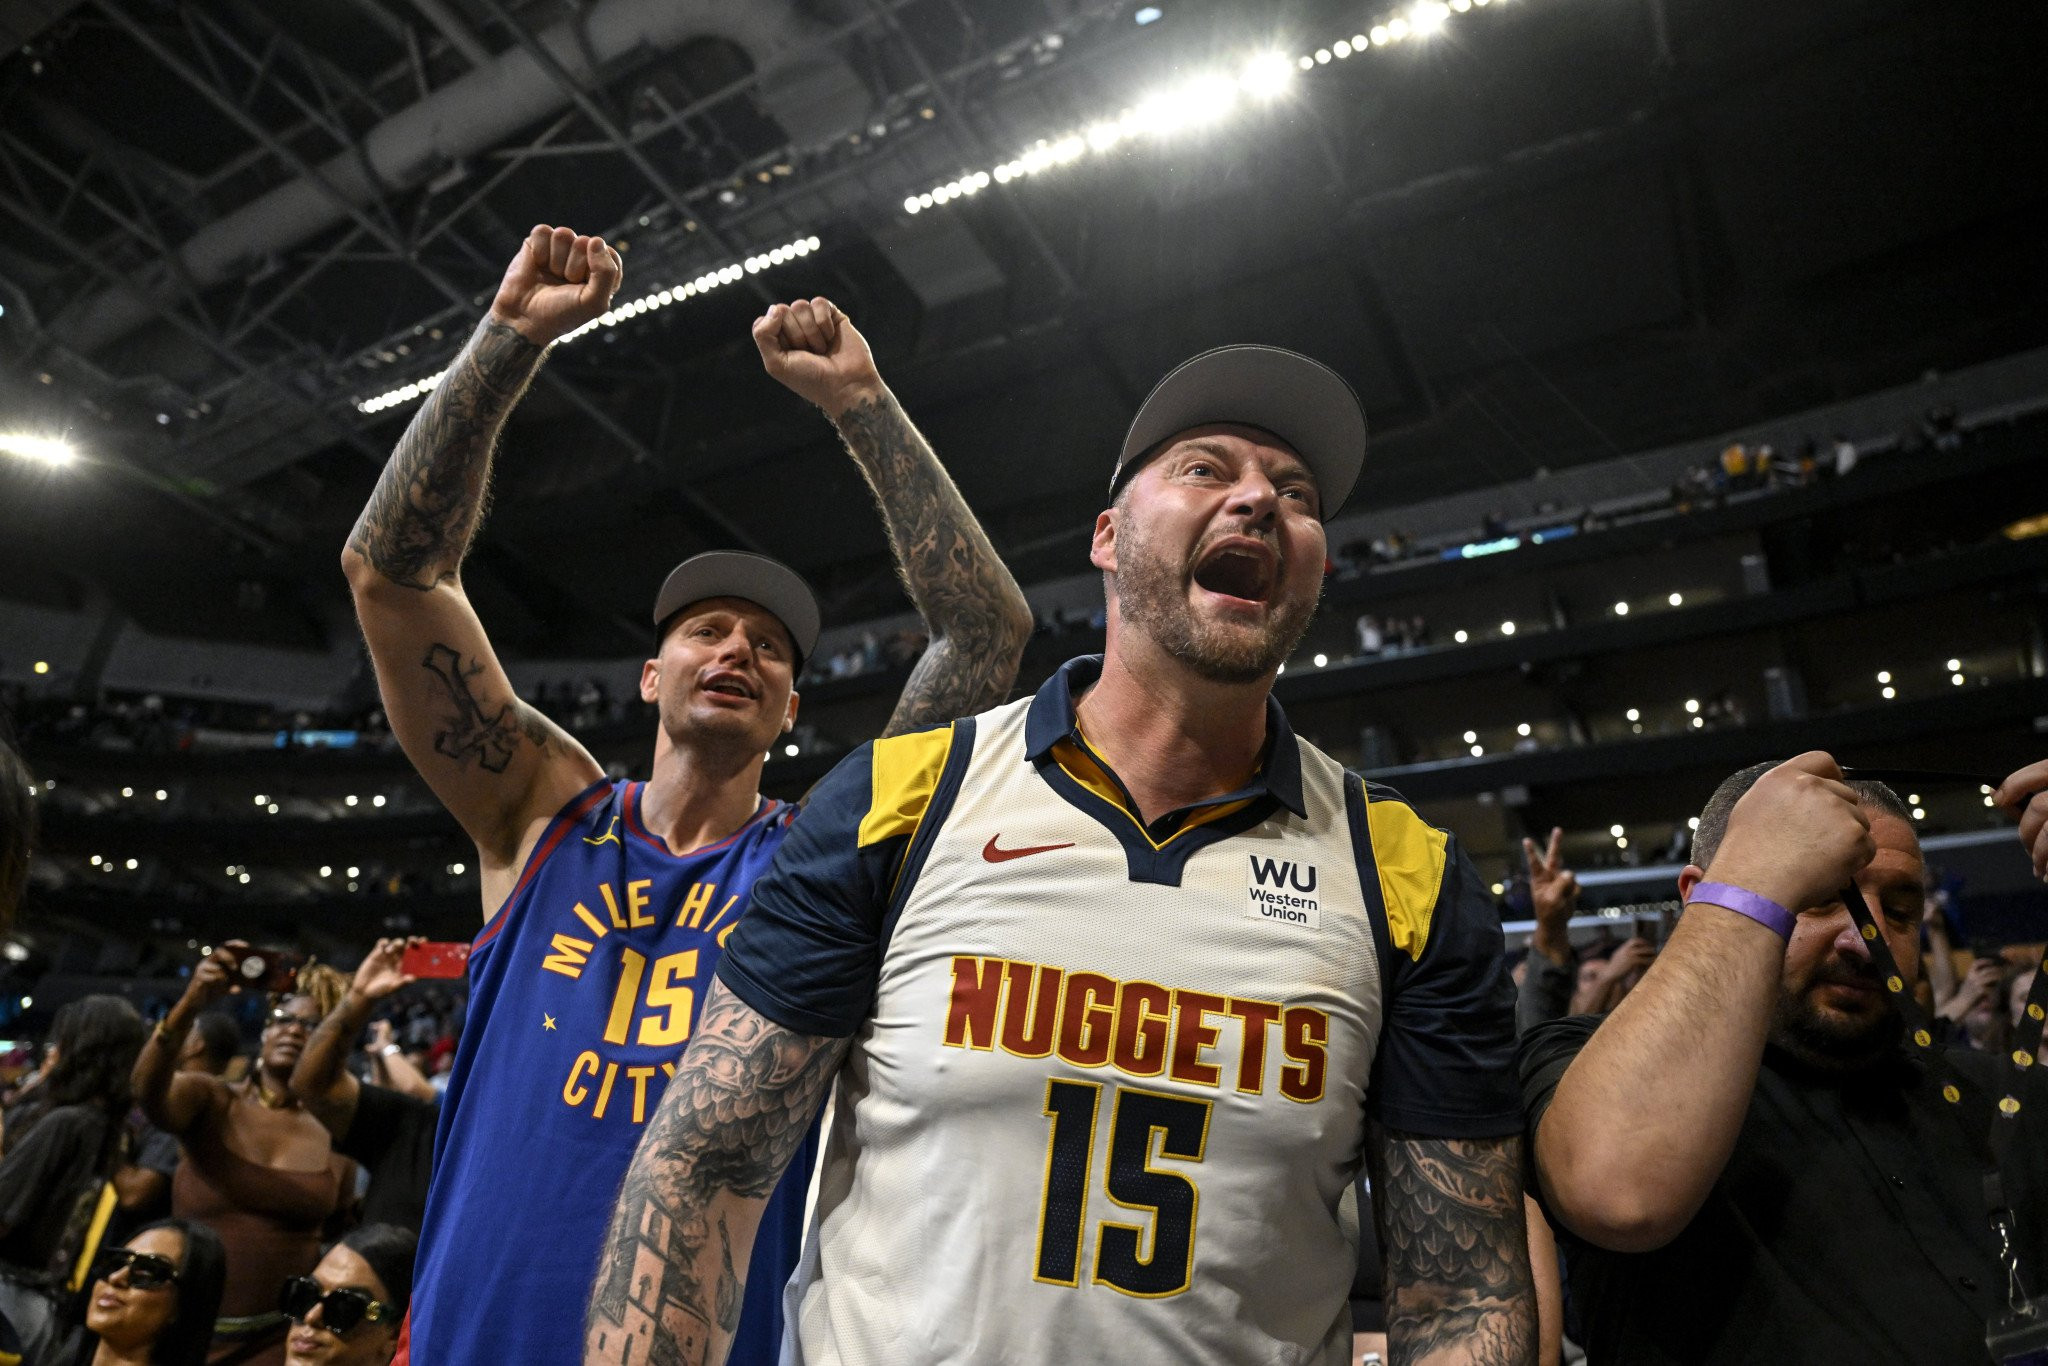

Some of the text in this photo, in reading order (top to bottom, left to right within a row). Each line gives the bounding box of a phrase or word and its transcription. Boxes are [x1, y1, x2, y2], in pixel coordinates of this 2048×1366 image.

[1249, 854, 1317, 892] WU
[1249, 887, 1318, 911] Western
[1261, 903, 1307, 924] Union
[541, 878, 655, 979] MILE
[603, 947, 698, 1046] 15
[942, 955, 1329, 1104] NUGGETS
[562, 1049, 676, 1123] CIT
[1033, 1076, 1214, 1299] 15
